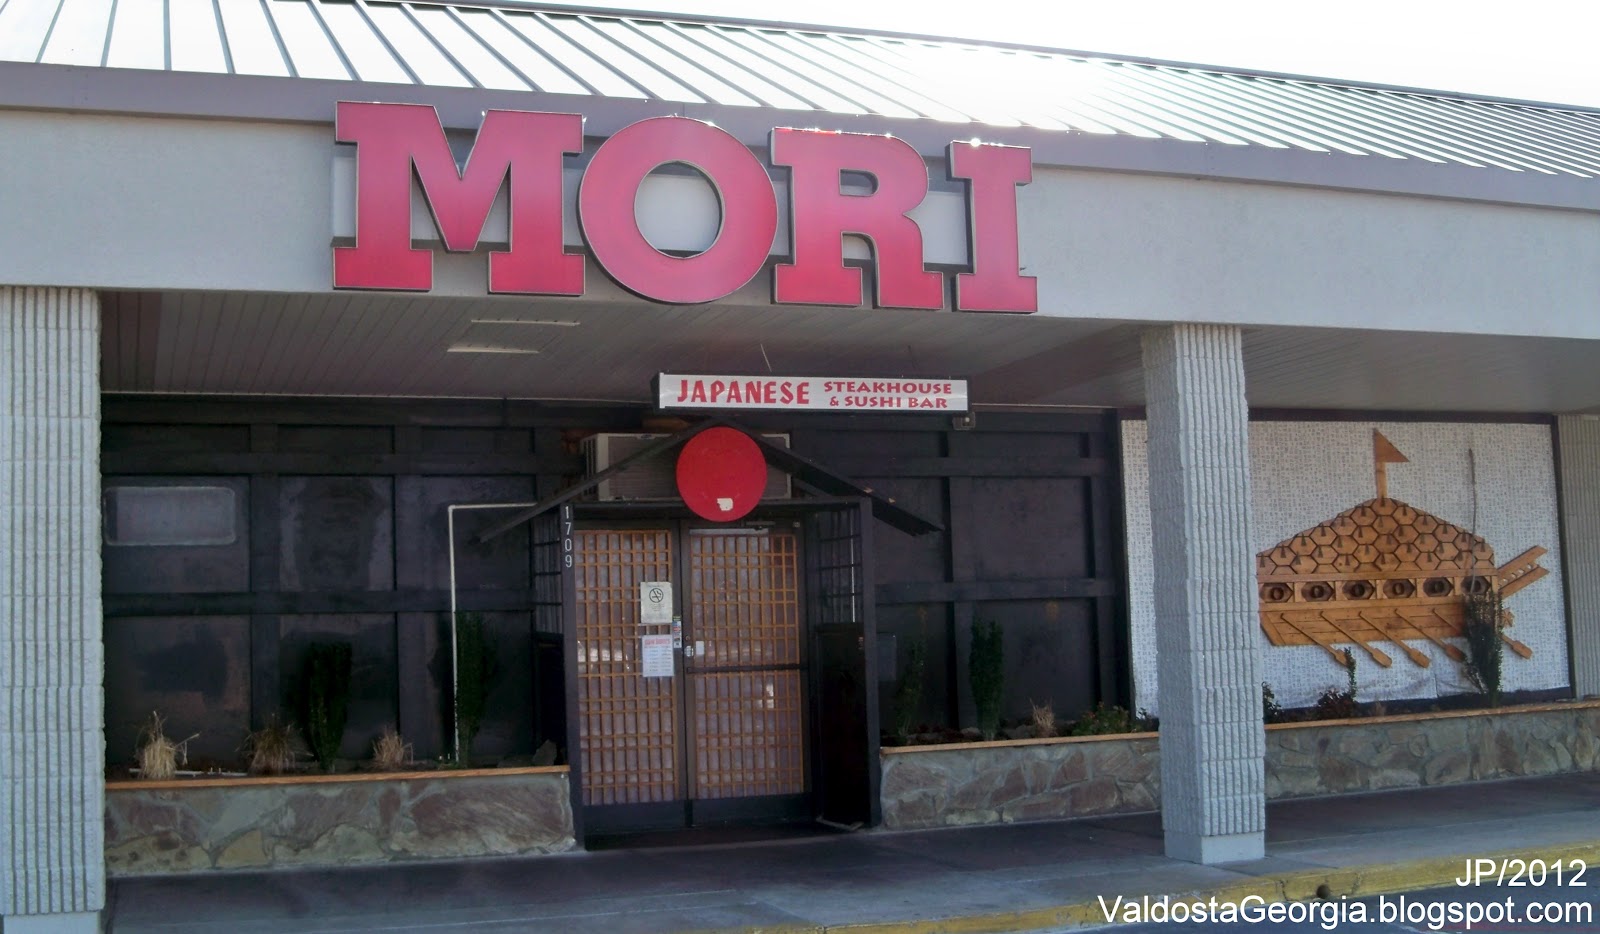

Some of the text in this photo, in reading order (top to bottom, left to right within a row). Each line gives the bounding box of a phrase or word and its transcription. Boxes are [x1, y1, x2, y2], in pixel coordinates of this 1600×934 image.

[332, 100, 1039, 314] MORI
[677, 379, 810, 404] JAPANESE
[823, 381, 952, 395] STEAKHOUSE
[829, 396, 948, 409] & SUSHI BAR
[565, 505, 573, 568] 1709
